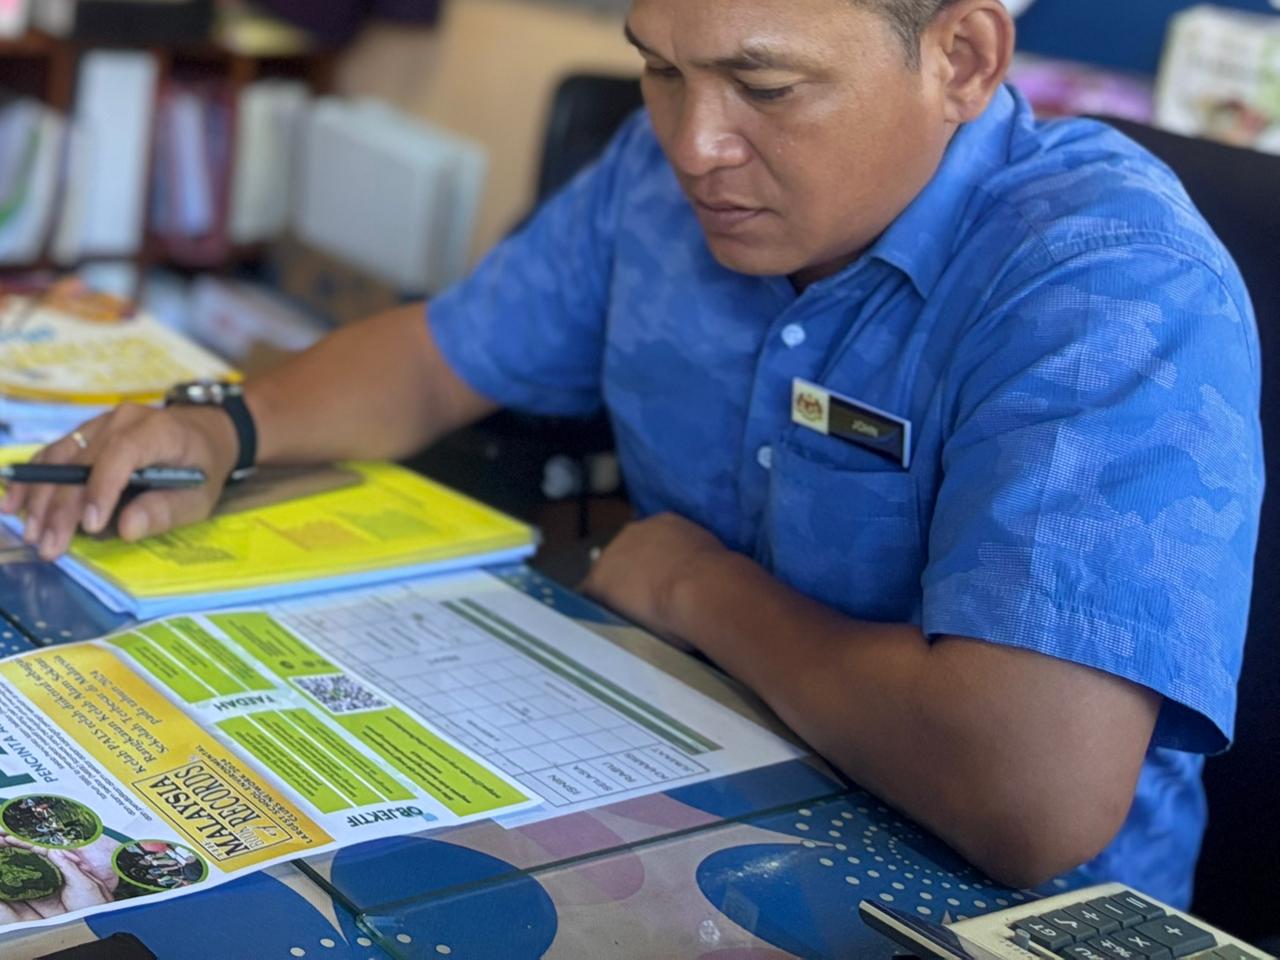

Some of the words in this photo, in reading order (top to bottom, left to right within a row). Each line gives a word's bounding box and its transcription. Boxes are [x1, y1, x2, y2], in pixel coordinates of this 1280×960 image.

[88, 728, 121, 750] PALS
[0, 734, 60, 783] PENCINTA
[167, 764, 265, 827] RECORDS
[147, 776, 250, 856] MALAYSIA
[346, 806, 424, 827] OBJEKTIF
[1028, 923, 1057, 937] GT
